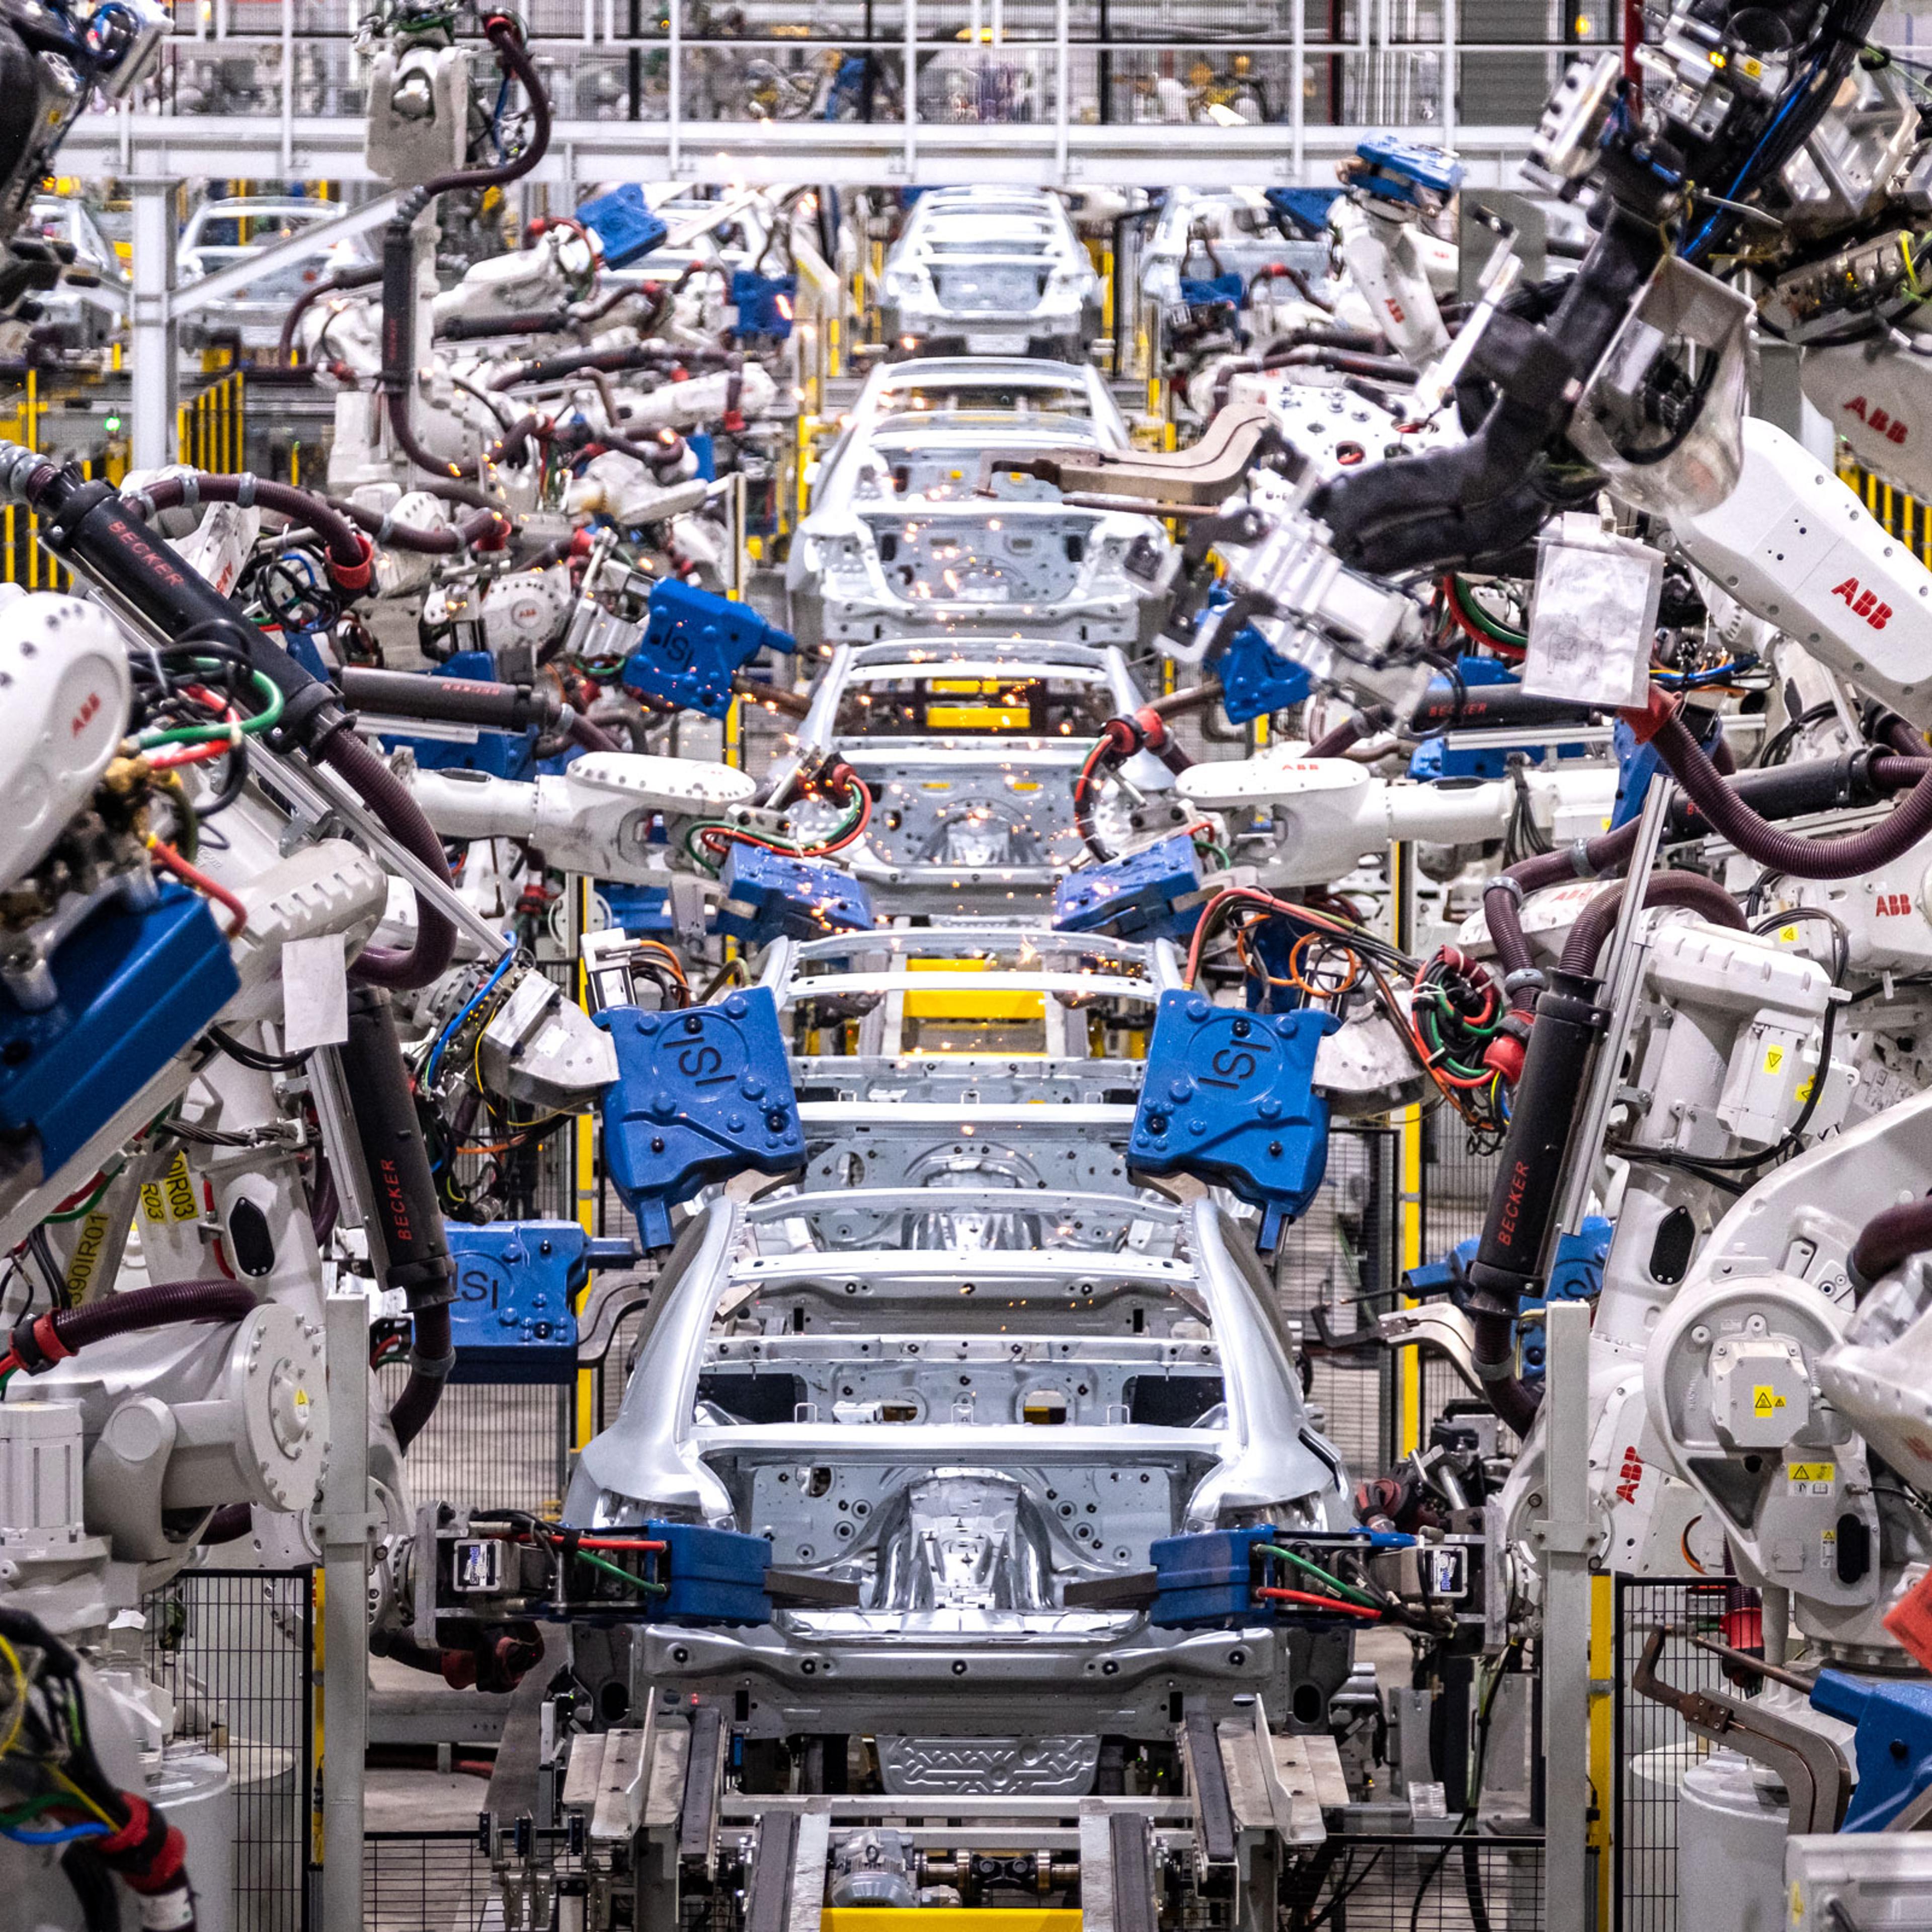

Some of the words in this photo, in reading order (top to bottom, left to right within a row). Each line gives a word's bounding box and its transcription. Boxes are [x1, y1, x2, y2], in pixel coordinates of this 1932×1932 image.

[1843, 396, 1908, 445] ABB
[108, 521, 185, 586] BECKER
[1831, 577, 1893, 630] ABB
[70, 692, 101, 738] ABB
[1875, 893, 1912, 917] ABB
[663, 1036, 737, 1087] ISI
[1198, 1040, 1271, 1090] ISI
[381, 1159, 412, 1241] BECKER
[1496, 1160, 1528, 1246] BECKER
